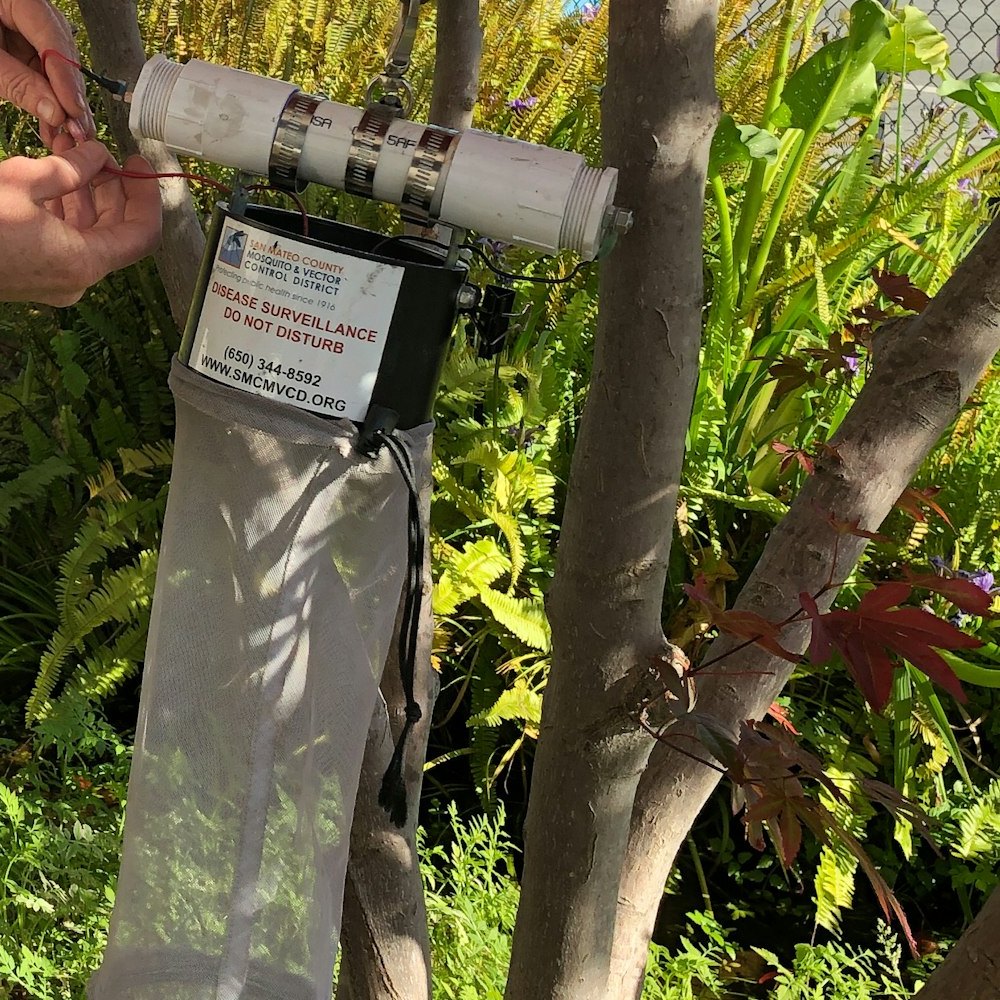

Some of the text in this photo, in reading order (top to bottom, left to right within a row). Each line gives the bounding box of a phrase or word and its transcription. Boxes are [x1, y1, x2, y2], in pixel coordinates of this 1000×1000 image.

[247, 251, 341, 285] MOSQUITO & VECTOR
[250, 240, 344, 274] SAN MATEO COUNTY
[245, 260, 339, 296] CONTROL DISTRICT
[265, 282, 290, 298] health
[292, 293, 313, 305] since
[316, 299, 336, 311] 1916
[211, 281, 378, 343] DISEASE SURVEILLANCE
[223, 306, 345, 354] DO NOT DISTURB
[201, 354, 347, 412] WWW.SMCMVCD.ORG
[224, 345, 322, 387] (650) 344-8592
